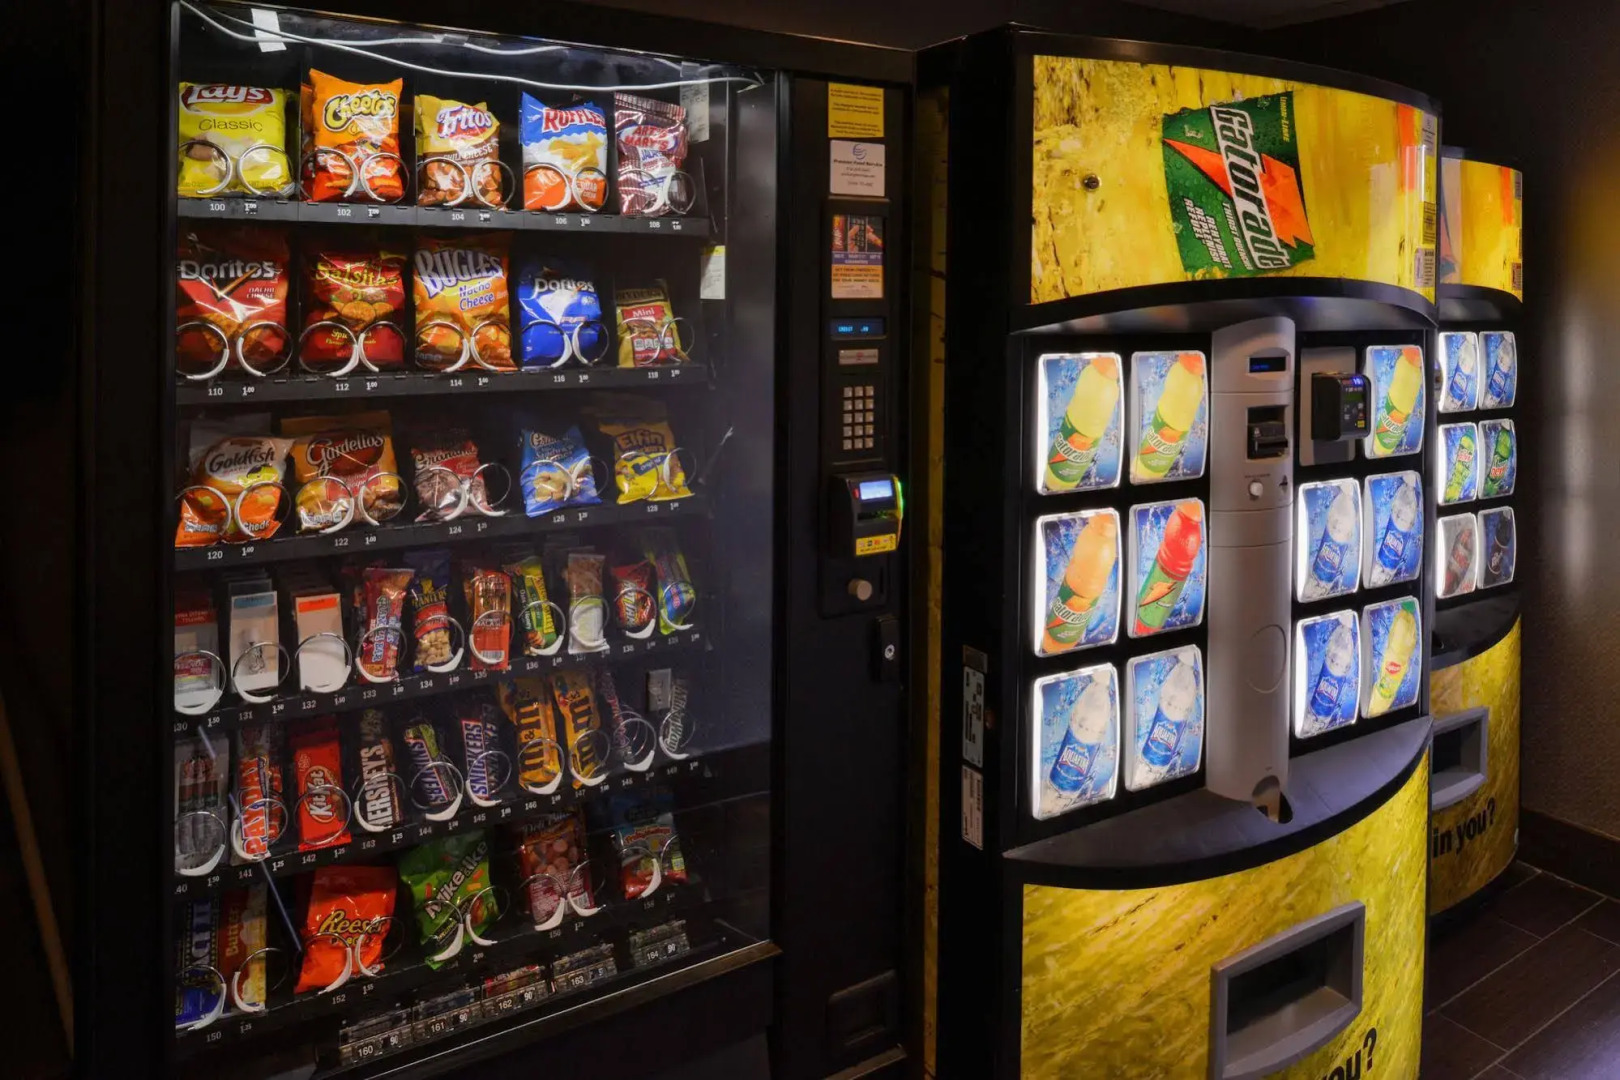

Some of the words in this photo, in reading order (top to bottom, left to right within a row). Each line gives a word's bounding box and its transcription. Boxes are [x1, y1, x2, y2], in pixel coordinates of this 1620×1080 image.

[325, 91, 397, 132] Cheetos
[199, 119, 264, 132] Classic
[437, 105, 493, 138] Fritos
[543, 108, 606, 132] RUFFLES
[1210, 105, 1291, 269] Gatorade
[209, 203, 226, 211] 100
[337, 208, 351, 217] 102
[451, 213, 465, 221] 104
[1194, 205, 1221, 263] REPLENISH
[1222, 201, 1239, 236] THIRST
[1233, 236, 1254, 270] QUENCHER
[1206, 215, 1232, 269] REHYDRATE
[180, 259, 275, 279] Doritos
[315, 261, 399, 286] Salsitas
[415, 249, 504, 298] BUGLES
[459, 281, 491, 297] Nacho
[534, 278, 595, 293] Doritos
[459, 293, 494, 311] Cheese
[632, 308, 656, 318] Mini
[335, 383, 350, 392] 112
[450, 379, 462, 387] 114
[208, 387, 223, 396] 110
[208, 446, 275, 472] Goldfish
[449, 525, 462, 534] 124
[334, 538, 349, 546] 122
[207, 551, 223, 560] 120
[526, 661, 539, 670] 136
[474, 671, 488, 680] 135
[420, 680, 434, 689] 134
[363, 690, 377, 699] 133
[302, 700, 317, 710] 132
[238, 711, 253, 721] 131
[463, 720, 488, 799] SNICKERS
[360, 744, 392, 828] HERSHEY'S
[575, 788, 586, 797] 147
[239, 756, 268, 857] PAYDAY
[525, 801, 537, 811] 146
[473, 813, 486, 823] 145
[1456, 797, 1496, 854] you?
[419, 827, 432, 837] 144
[362, 840, 376, 850] 143
[301, 854, 316, 865] 142
[238, 869, 252, 879] 141
[424, 870, 465, 919] Mike
[571, 975, 584, 986] 163
[331, 994, 346, 1005] 152
[498, 998, 512, 1010] 162
[430, 1021, 445, 1033] 161
[206, 1031, 221, 1042] 150
[357, 1045, 374, 1057] 160
